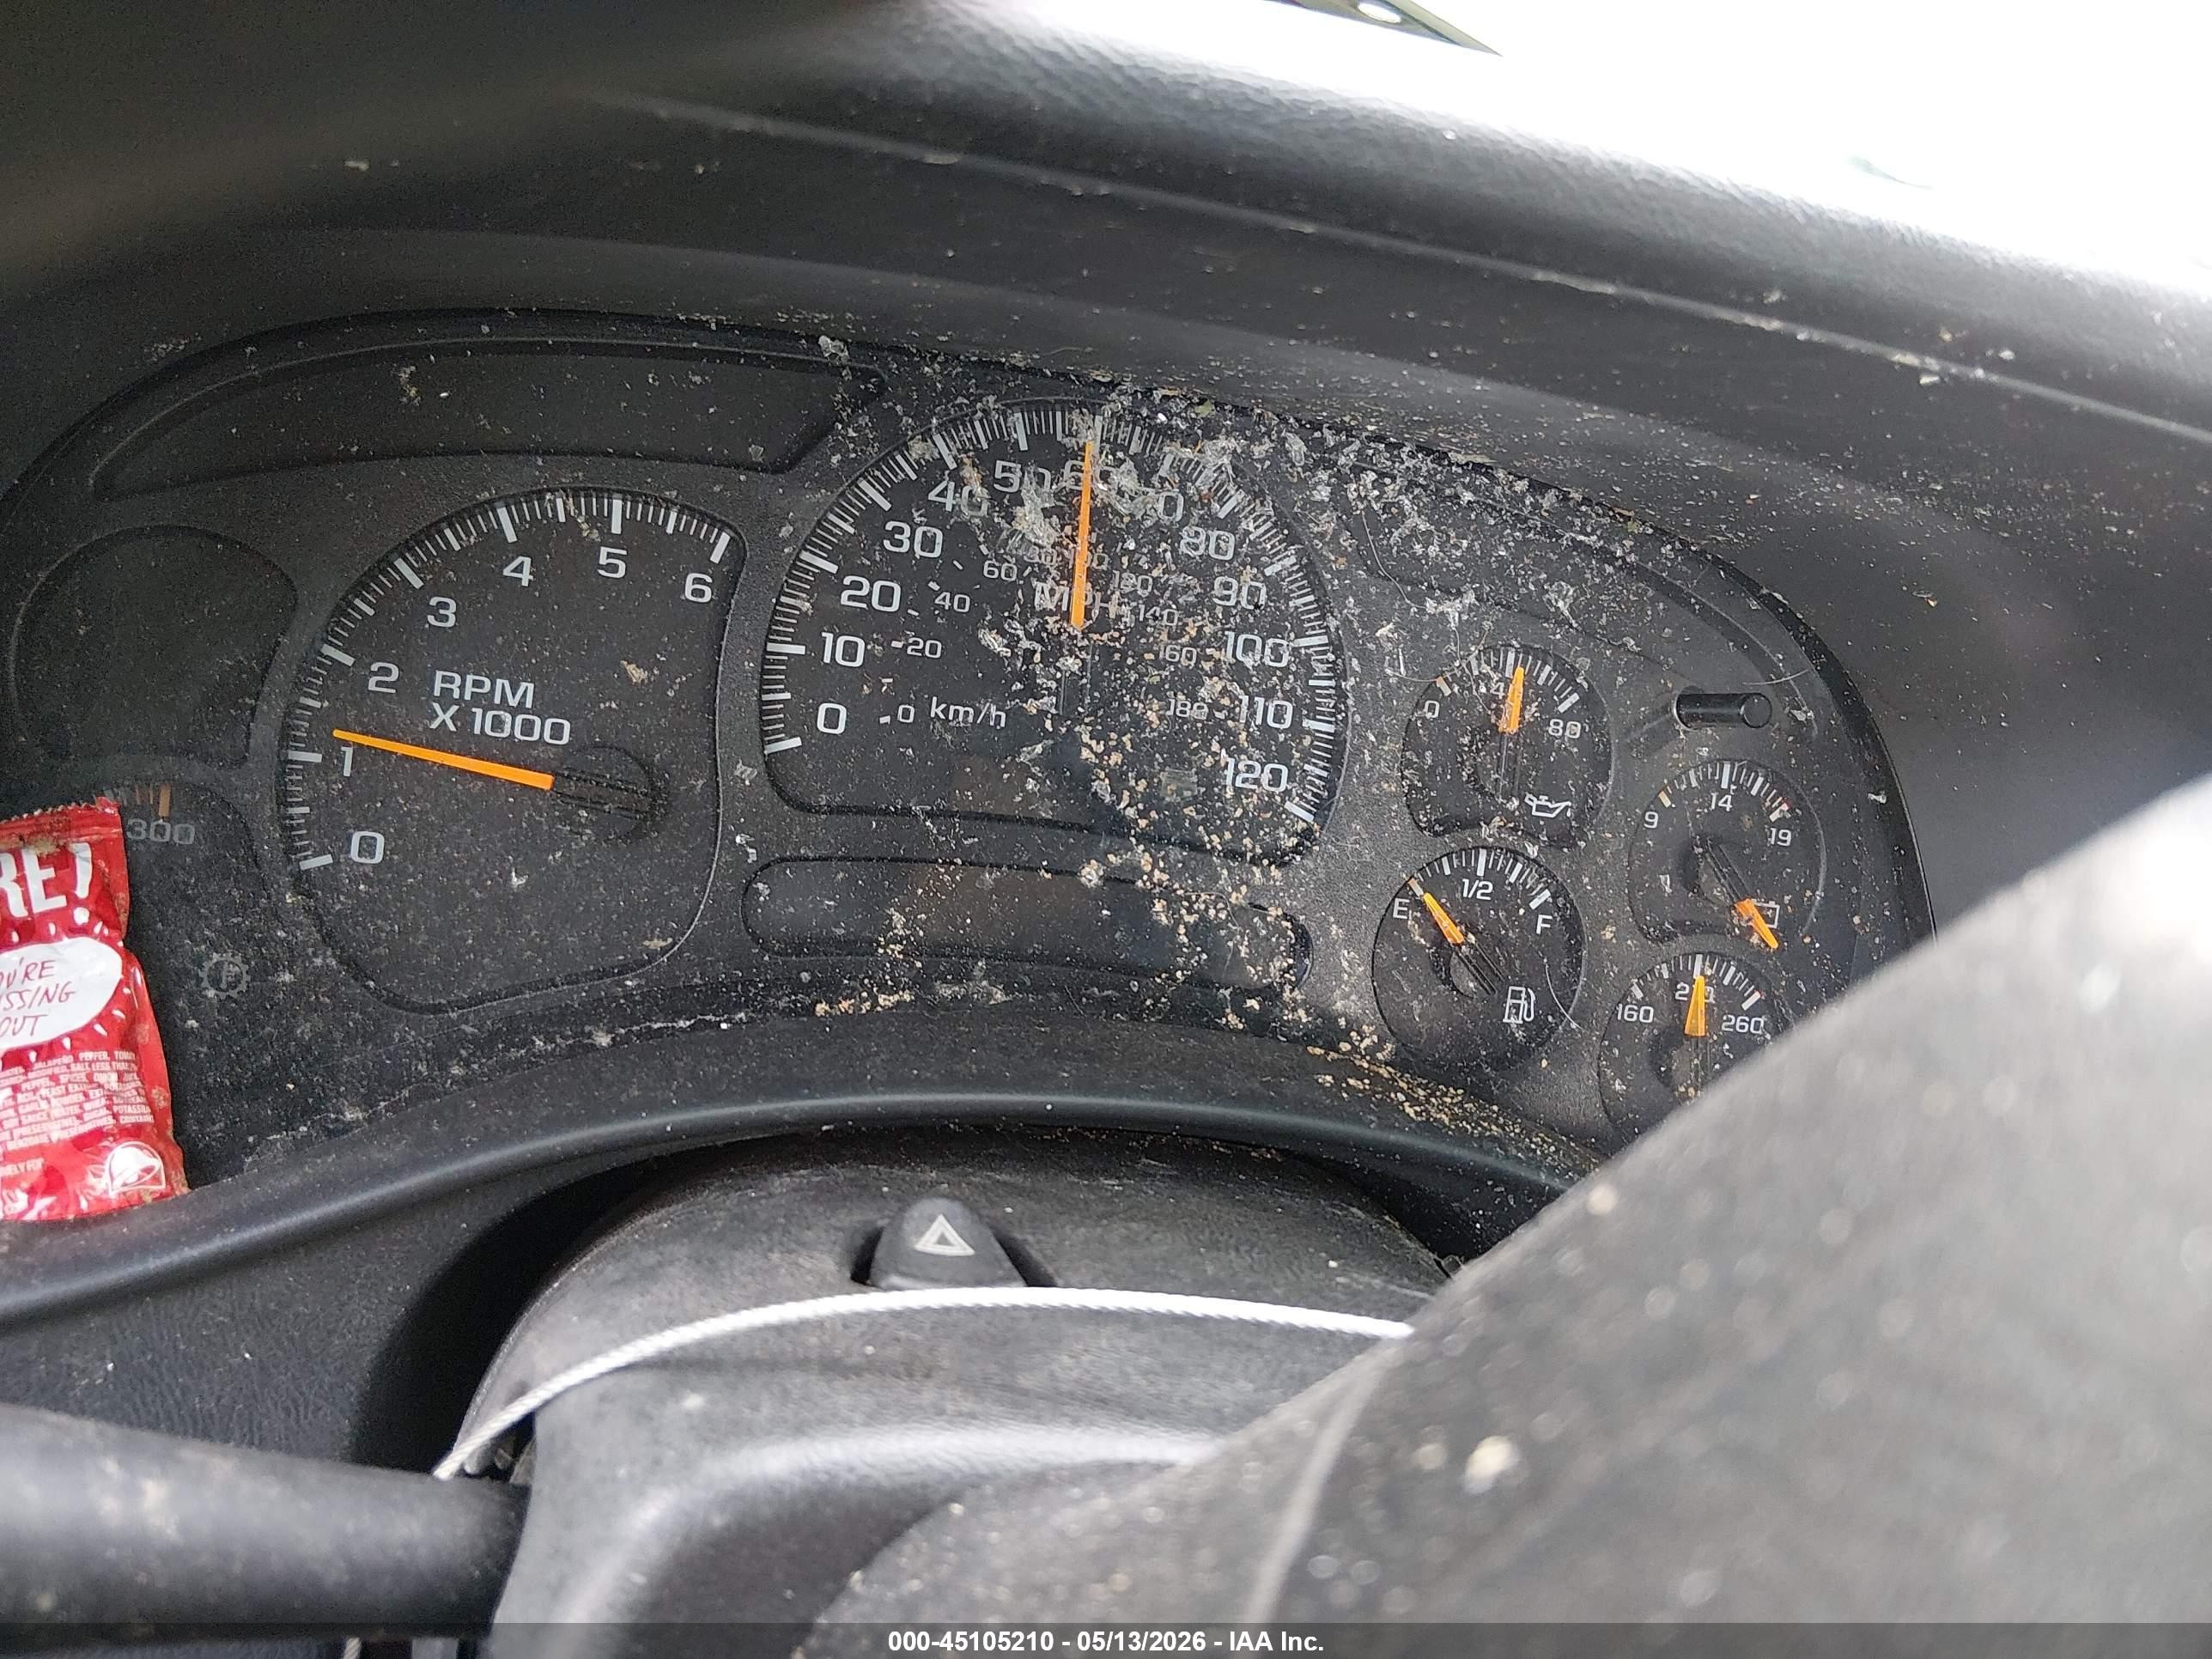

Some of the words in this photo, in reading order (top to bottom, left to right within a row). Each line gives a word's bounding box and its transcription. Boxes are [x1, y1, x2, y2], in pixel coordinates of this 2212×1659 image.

[928, 480, 988, 517] 40
[883, 520, 943, 558] 30
[1180, 526, 1235, 560] 80
[503, 556, 533, 586] 4
[598, 547, 627, 579] 5
[983, 560, 1018, 581] 60
[685, 573, 713, 604] 6
[840, 575, 901, 613] 20
[934, 592, 970, 613] 40
[1212, 576, 1267, 610] 90
[428, 597, 457, 628] 3
[821, 631, 866, 667] 10
[907, 638, 942, 659] 20
[1224, 630, 1290, 667] 100
[368, 662, 399, 694] 2
[434, 671, 535, 708] RPM
[429, 703, 458, 732] X
[471, 707, 571, 745] 1000
[817, 702, 847, 734] 0
[897, 704, 915, 723] 0
[930, 696, 1006, 728] km/h
[1238, 695, 1293, 729] 110
[1424, 700, 1440, 719] 0
[1548, 718, 1582, 739] 80
[341, 747, 354, 776] 1
[1225, 757, 1288, 792] 120
[1711, 792, 1734, 812] 14
[127, 817, 196, 845] 300
[1644, 811, 1659, 829] 9
[350, 830, 385, 864] 0
[1770, 827, 1792, 847] 19
[1462, 878, 1493, 901] 1/2
[1393, 897, 1410, 920] E
[1535, 914, 1553, 935] F
[1674, 982, 1716, 1003] 20
[1616, 1003, 1655, 1024] 160
[1721, 1014, 1764, 1034] 260
